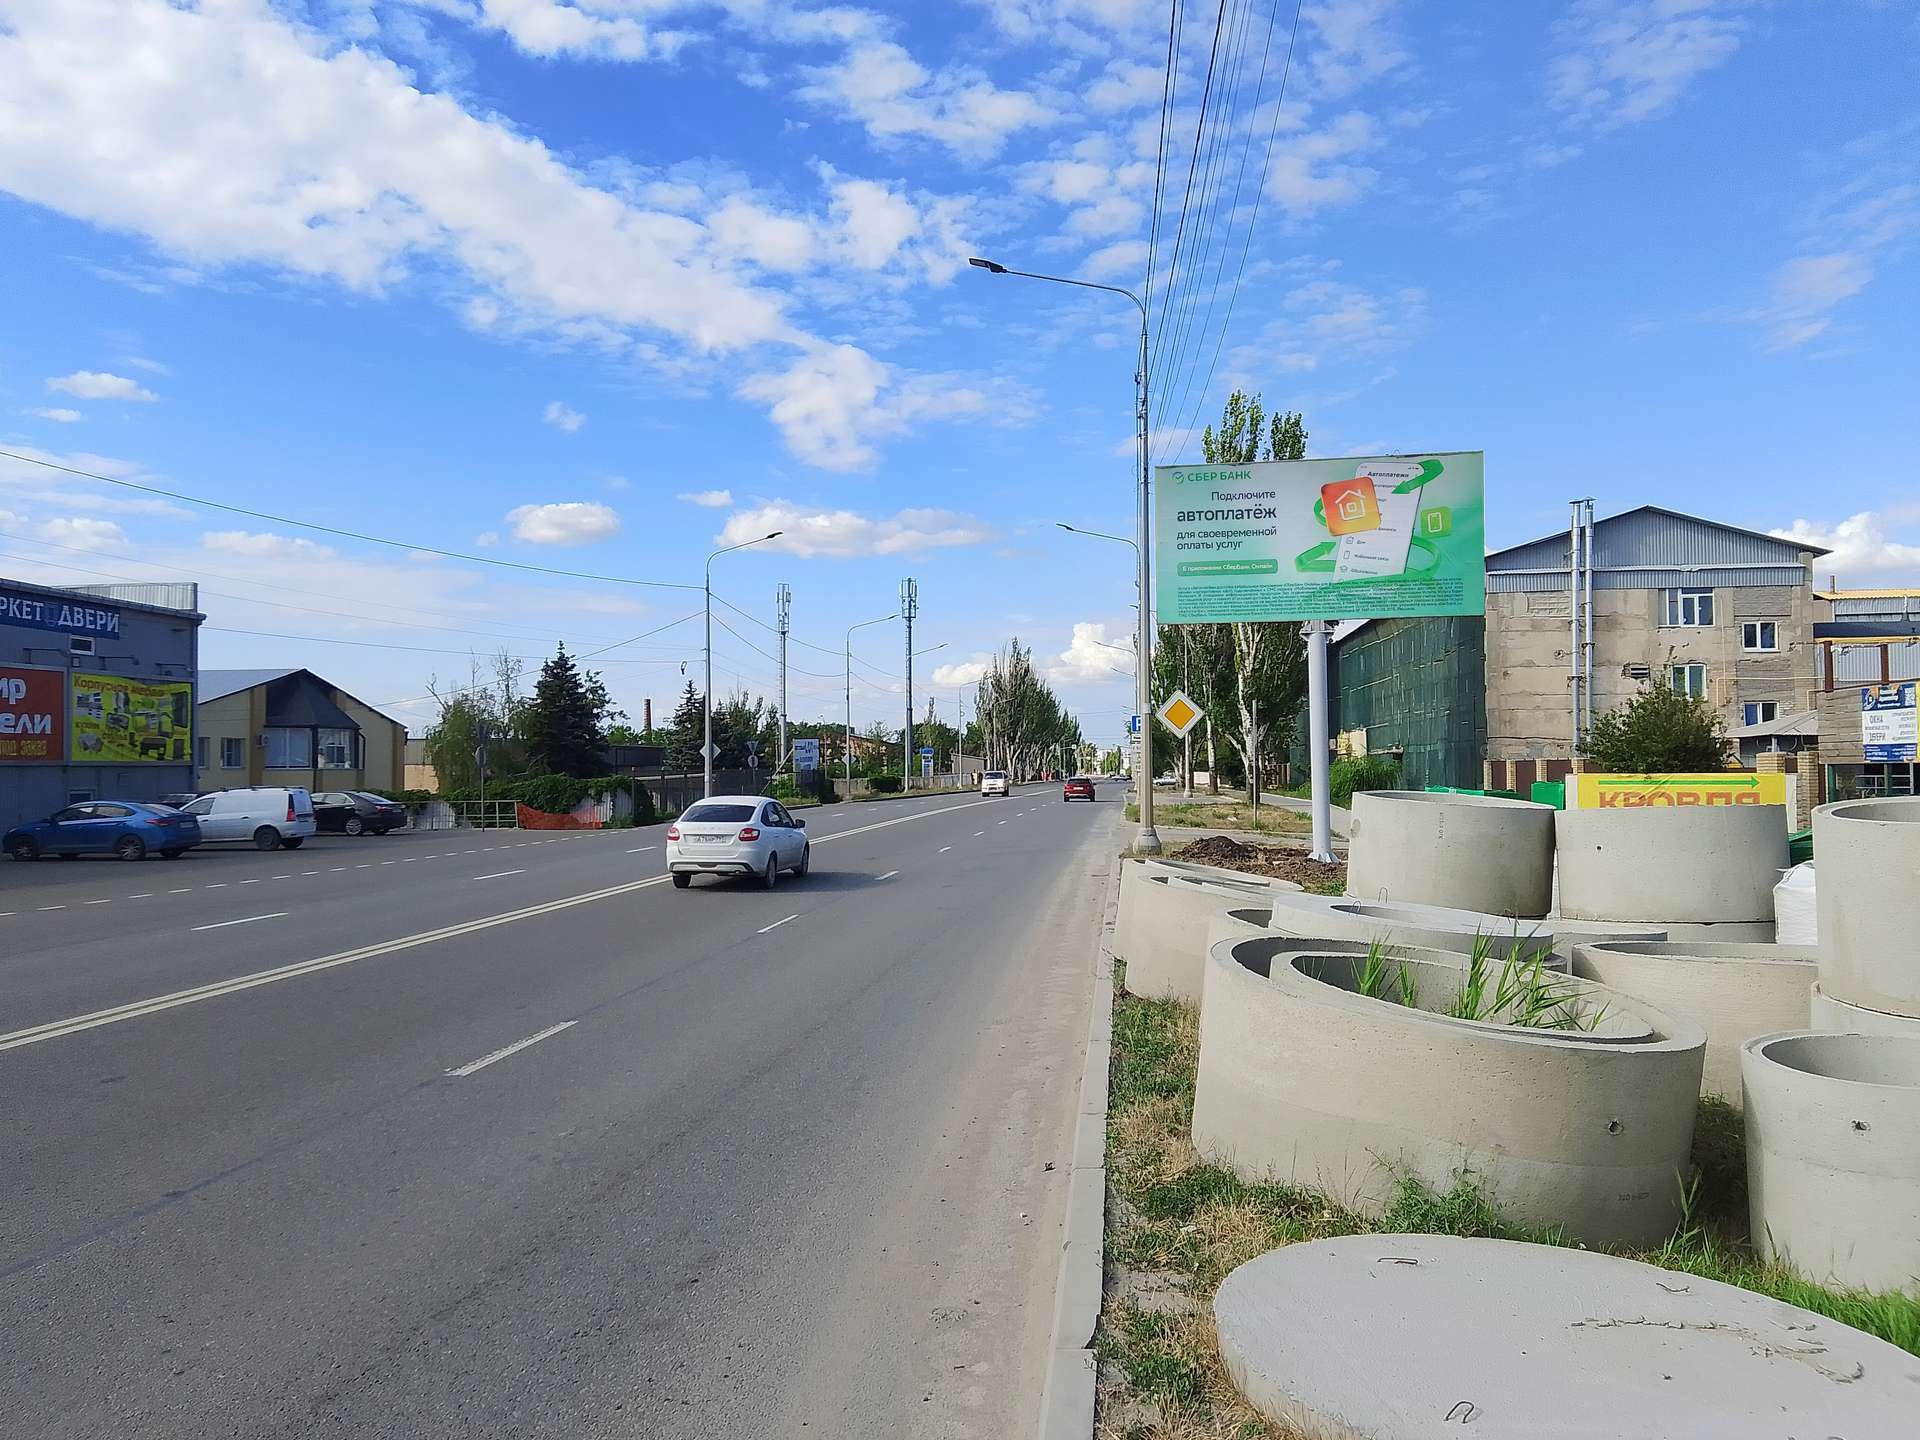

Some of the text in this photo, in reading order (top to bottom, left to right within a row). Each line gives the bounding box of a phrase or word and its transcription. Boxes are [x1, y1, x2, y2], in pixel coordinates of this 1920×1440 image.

[1187, 470, 1252, 482] СБЕР БАНК
[1211, 491, 1276, 501] Подключите
[1176, 503, 1277, 522] автоплатёж
[1176, 526, 1277, 540] для своевременной
[1176, 541, 1243, 551] оплаты услуг
[58, 605, 120, 633] ДВЕРИ
